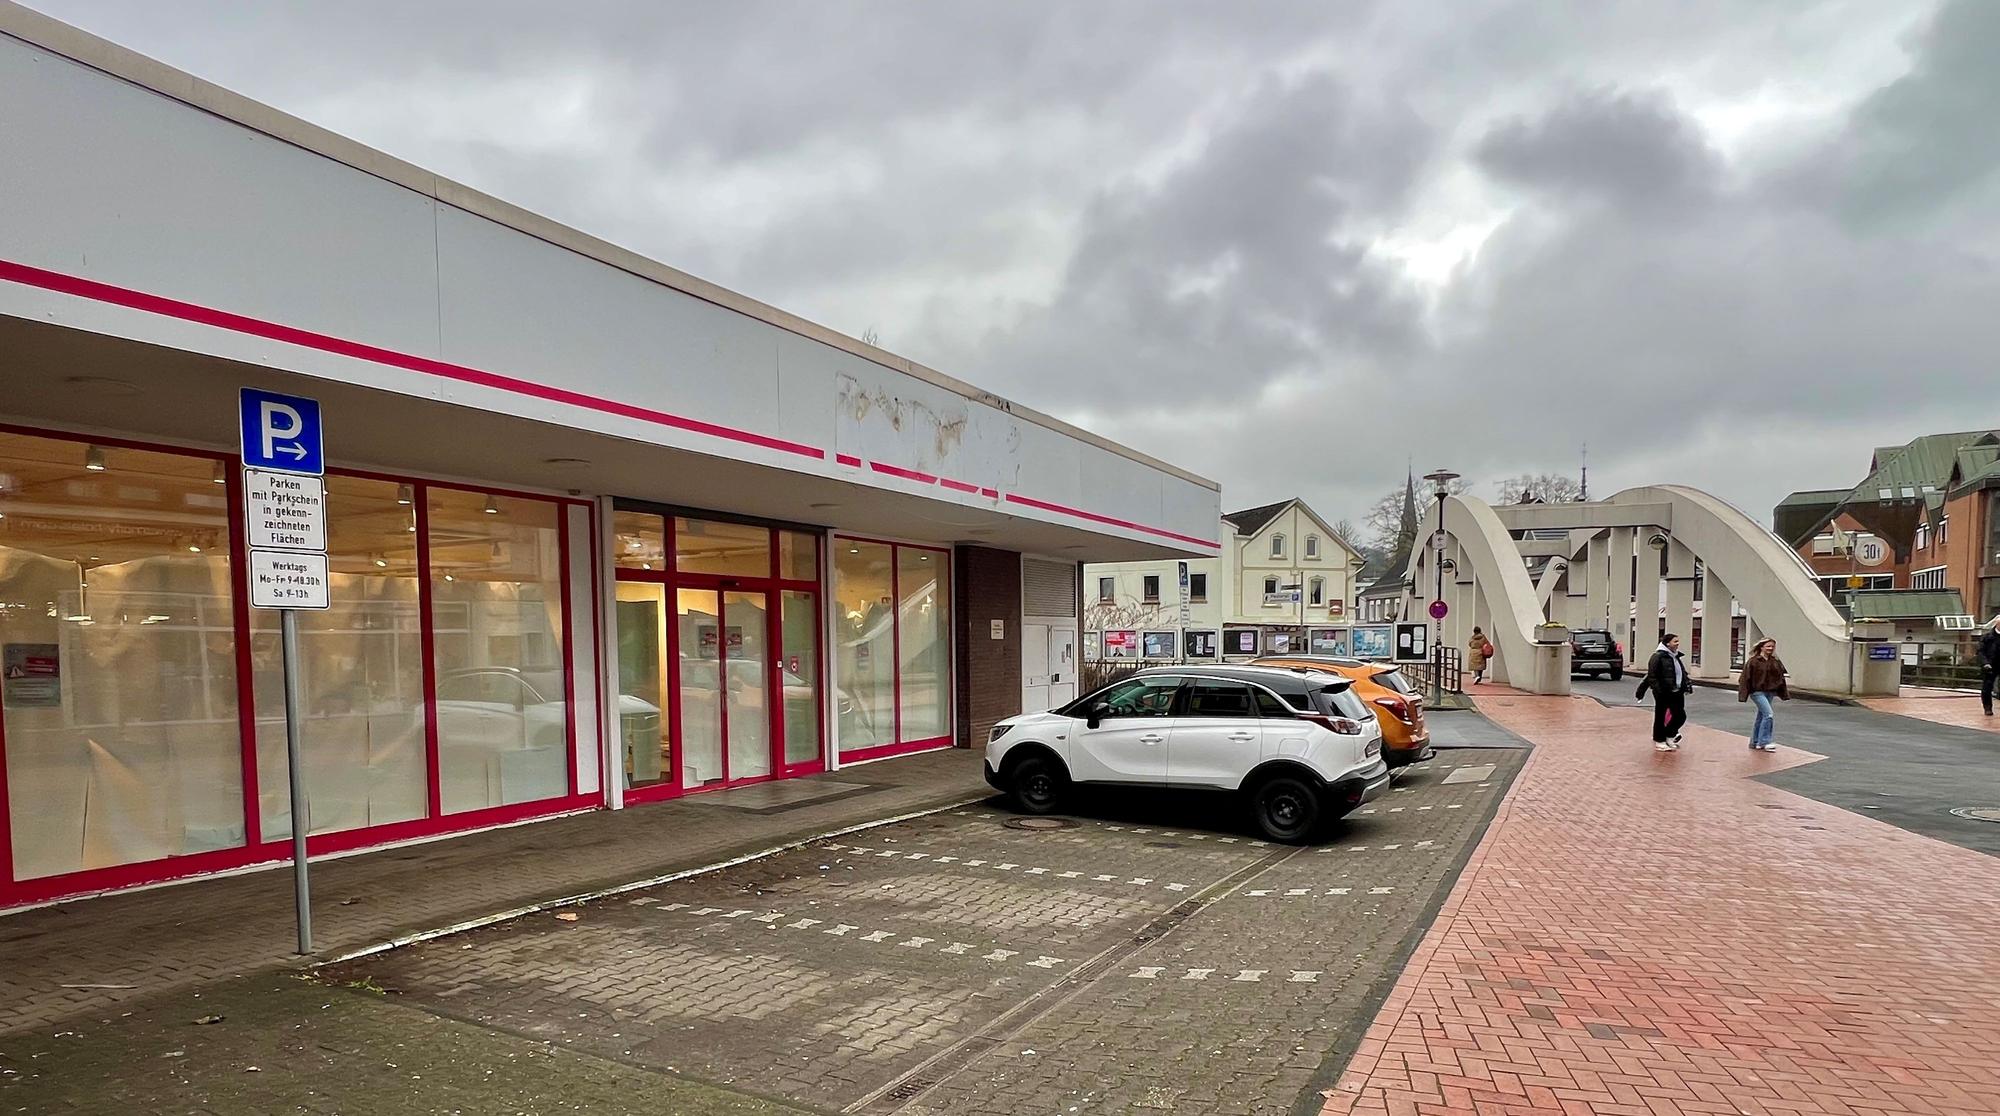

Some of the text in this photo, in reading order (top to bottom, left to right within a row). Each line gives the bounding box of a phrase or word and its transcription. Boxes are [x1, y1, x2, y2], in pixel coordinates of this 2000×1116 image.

[261, 401, 302, 458] P
[270, 477, 301, 490] Parken
[252, 491, 318, 505] mit Parkschein
[263, 505, 312, 518] in gekenn-
[264, 520, 311, 532] zeichneten
[271, 533, 305, 545] Flächen
[272, 561, 308, 573] Werktags
[273, 588, 283, 598] Sa
